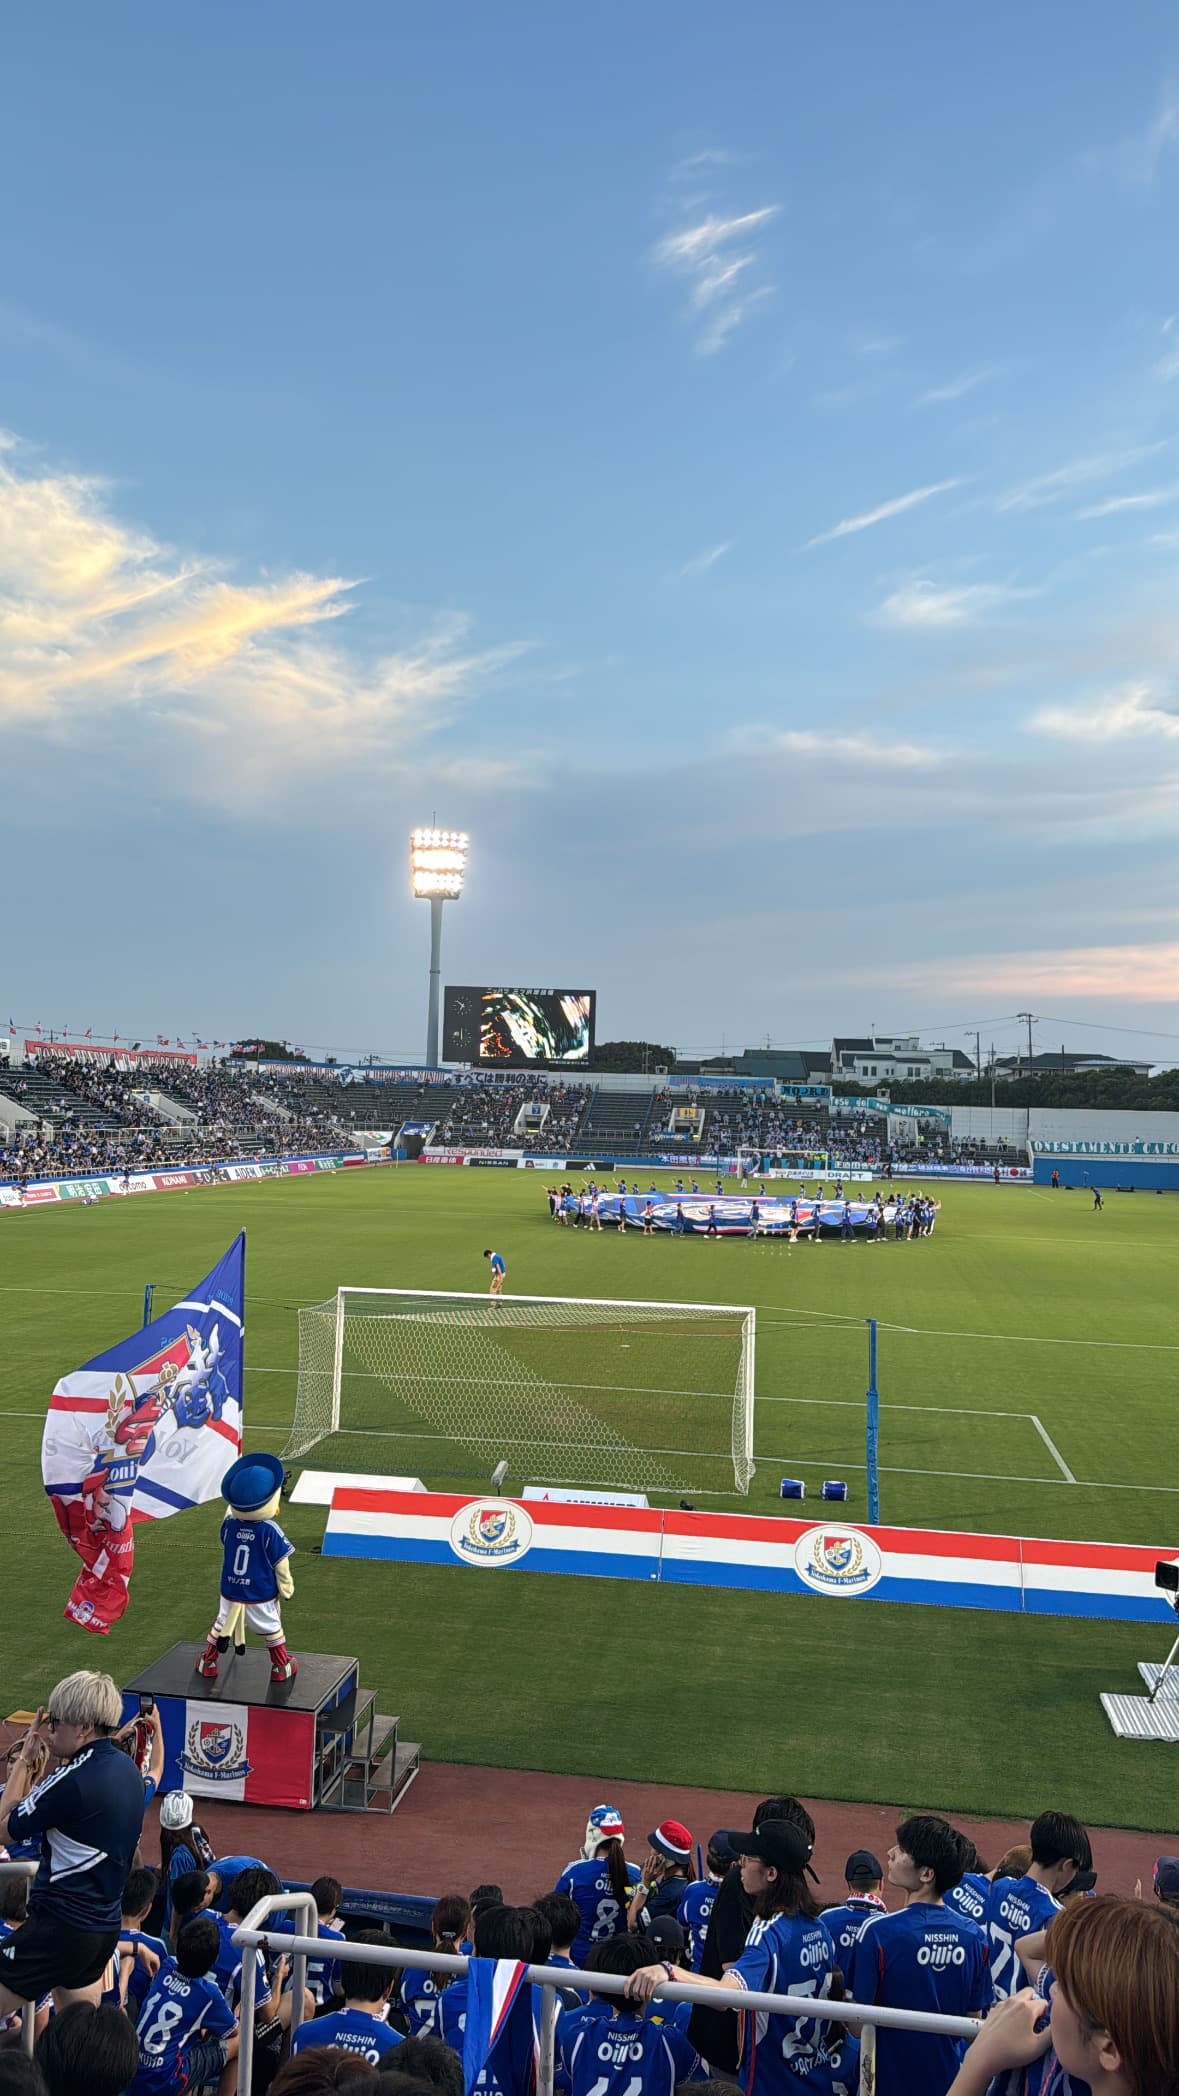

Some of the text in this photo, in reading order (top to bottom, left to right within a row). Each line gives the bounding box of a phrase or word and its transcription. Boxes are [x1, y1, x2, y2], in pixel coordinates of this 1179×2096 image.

[161, 1175, 187, 1186] KONAMI
[233, 1545, 250, 1576] 0
[924, 1934, 959, 1943] NISSHIN
[136, 1992, 183, 2055] 18
[335, 2032, 377, 2047] NISSHIN
